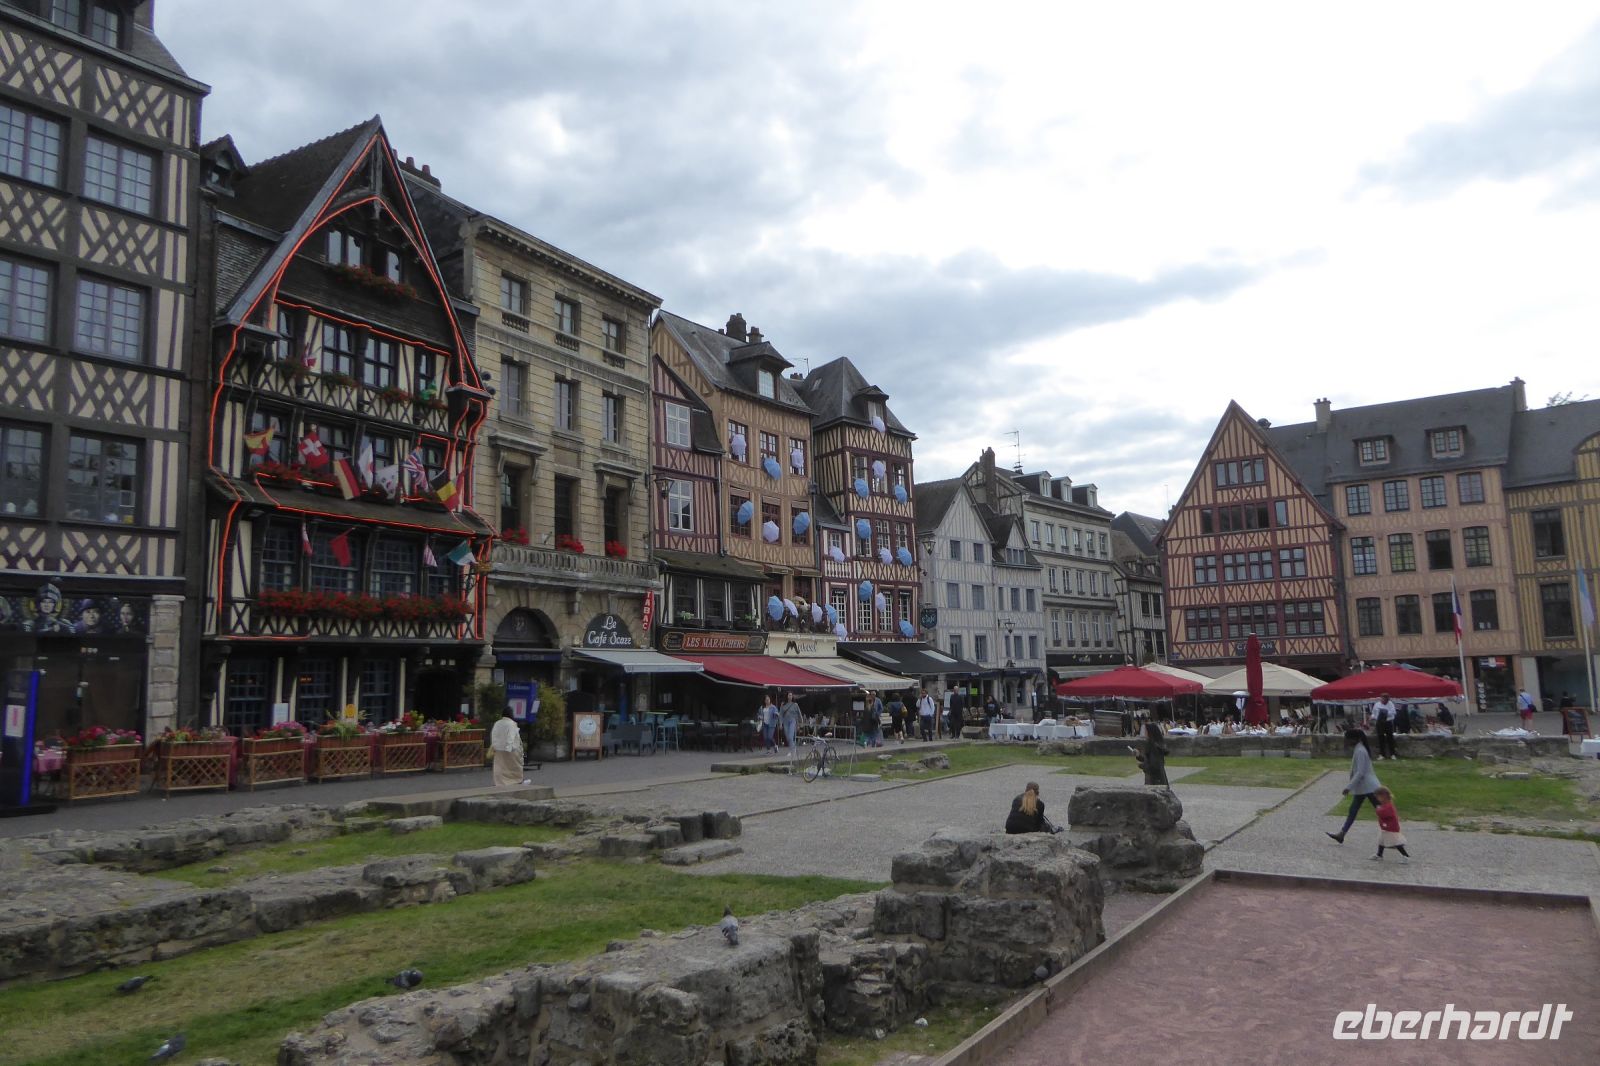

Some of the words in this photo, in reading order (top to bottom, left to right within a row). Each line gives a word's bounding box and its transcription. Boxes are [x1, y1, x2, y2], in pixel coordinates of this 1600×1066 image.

[642, 591, 652, 630] TABAC
[601, 615, 617, 630] Le
[588, 630, 607, 647] Café
[686, 637, 700, 648] LES
